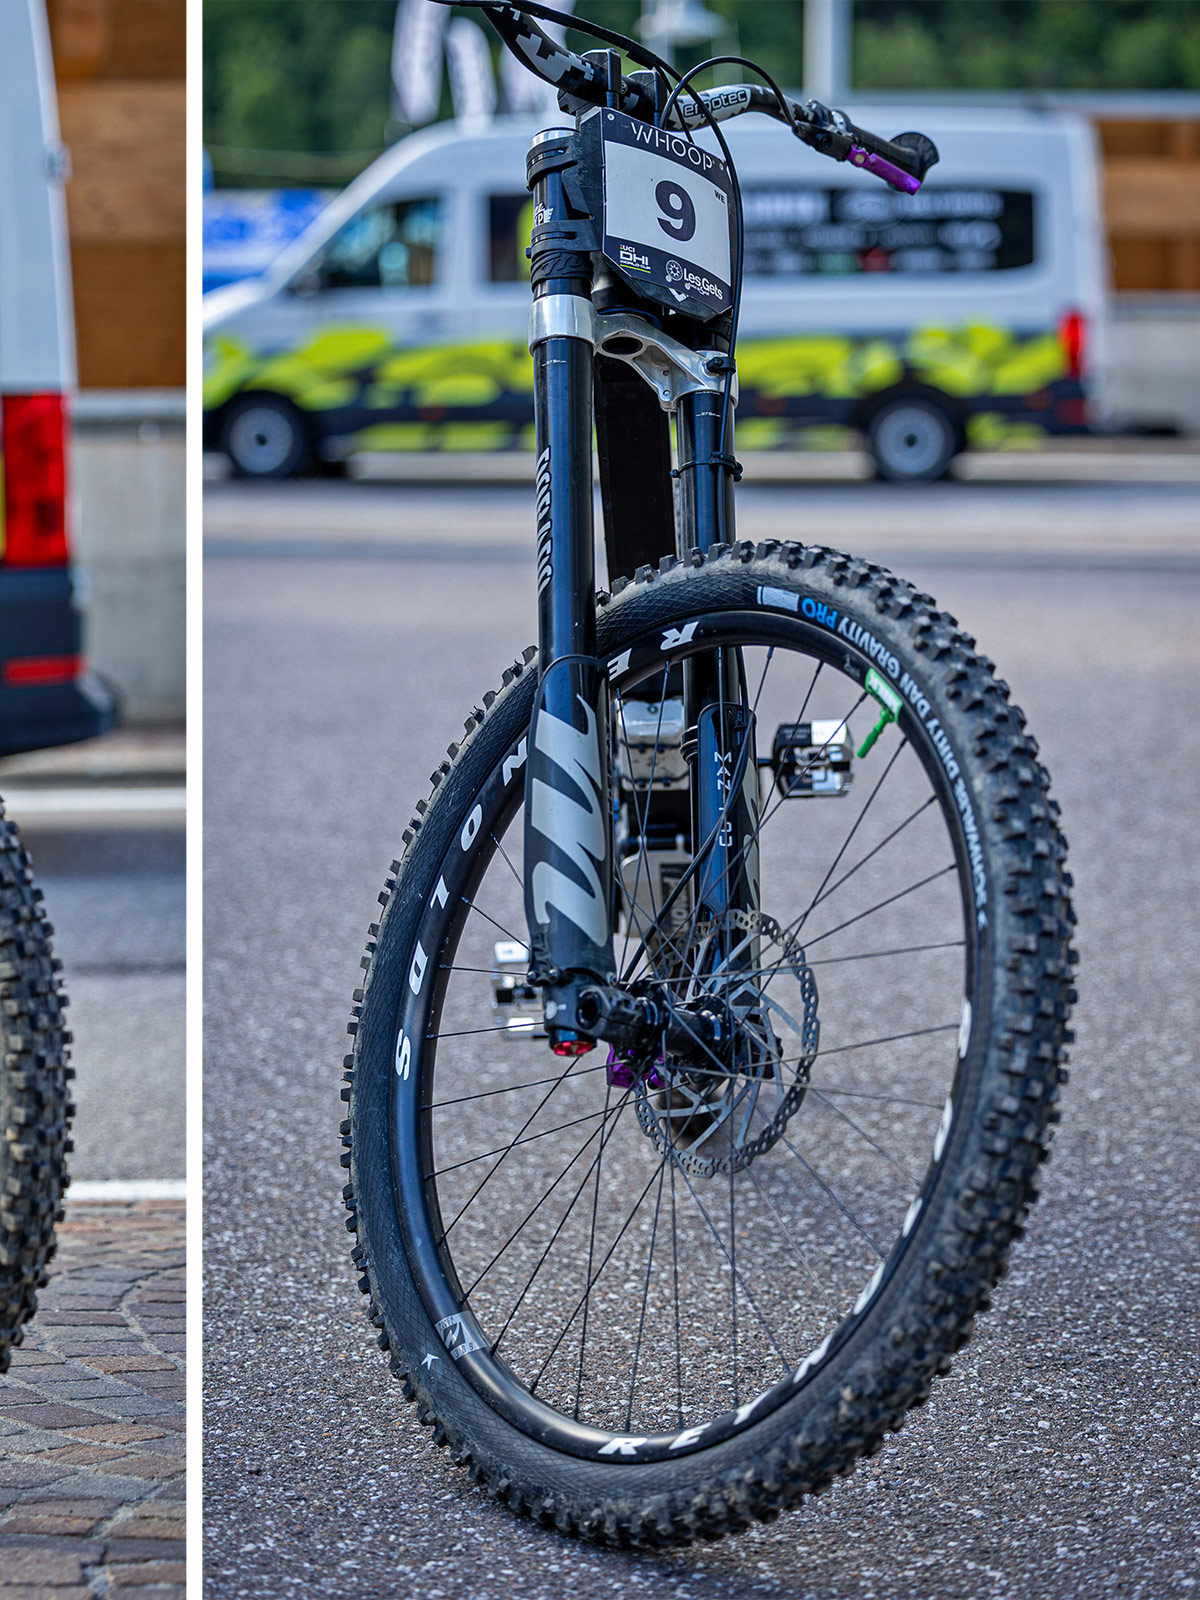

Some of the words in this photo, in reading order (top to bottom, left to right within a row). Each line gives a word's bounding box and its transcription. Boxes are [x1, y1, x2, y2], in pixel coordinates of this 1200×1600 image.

[631, 121, 714, 171] WHOOP
[655, 179, 697, 242] 9
[620, 250, 649, 266] DHI
[622, 244, 636, 253] UCI
[801, 597, 839, 629] PRO
[837, 616, 901, 680] GRAVITY
[899, 672, 931, 719] DAN
